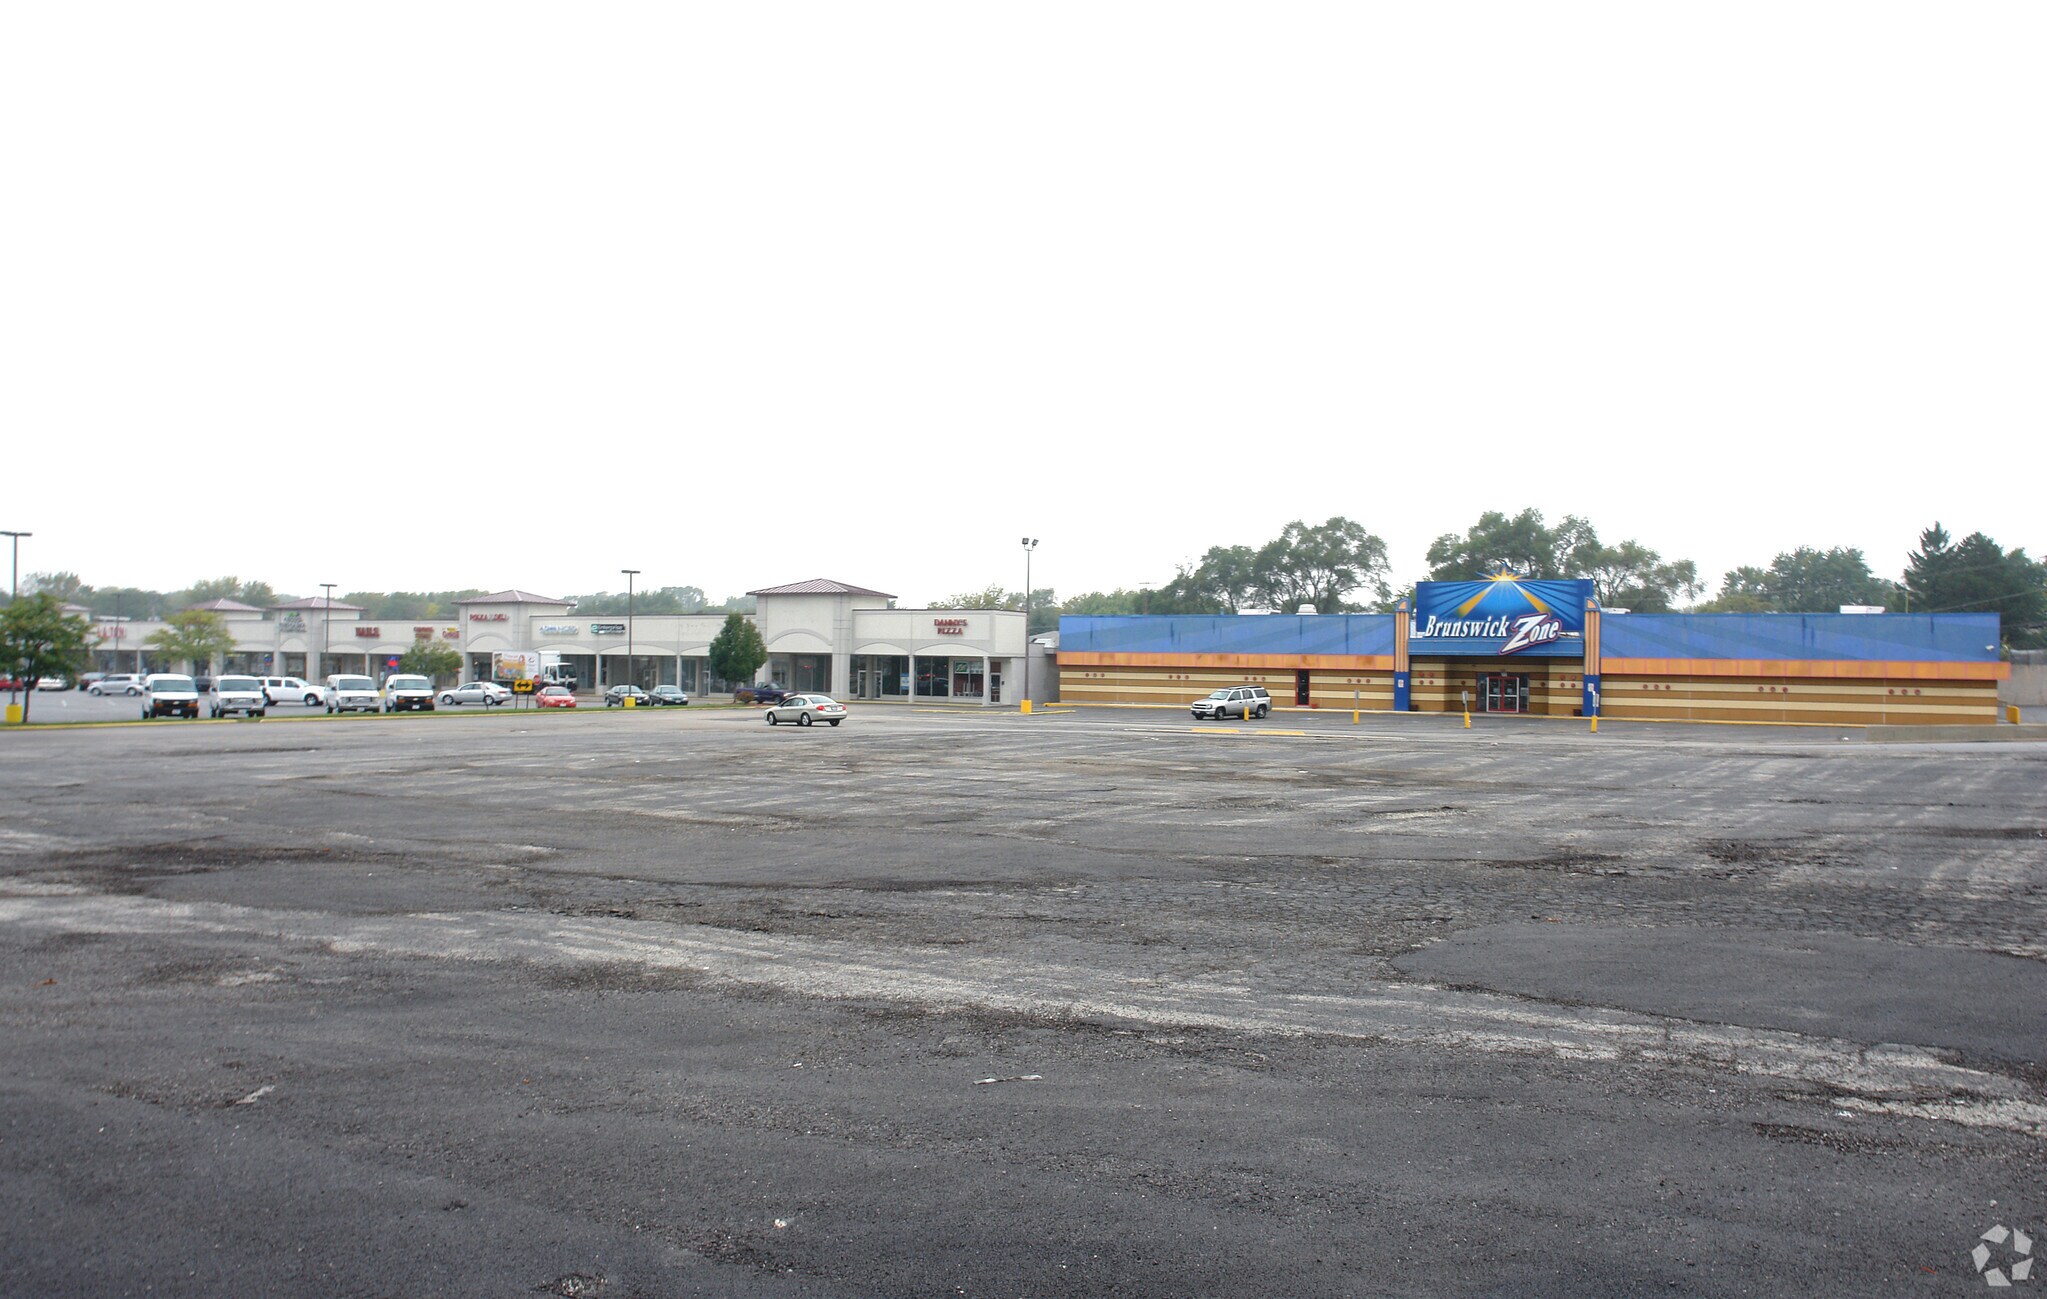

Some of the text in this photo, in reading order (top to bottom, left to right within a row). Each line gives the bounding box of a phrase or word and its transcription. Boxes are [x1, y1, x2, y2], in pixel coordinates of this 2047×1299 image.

[937, 627, 963, 635] PIZZA
[1424, 613, 1560, 653] Brunswick Zone
